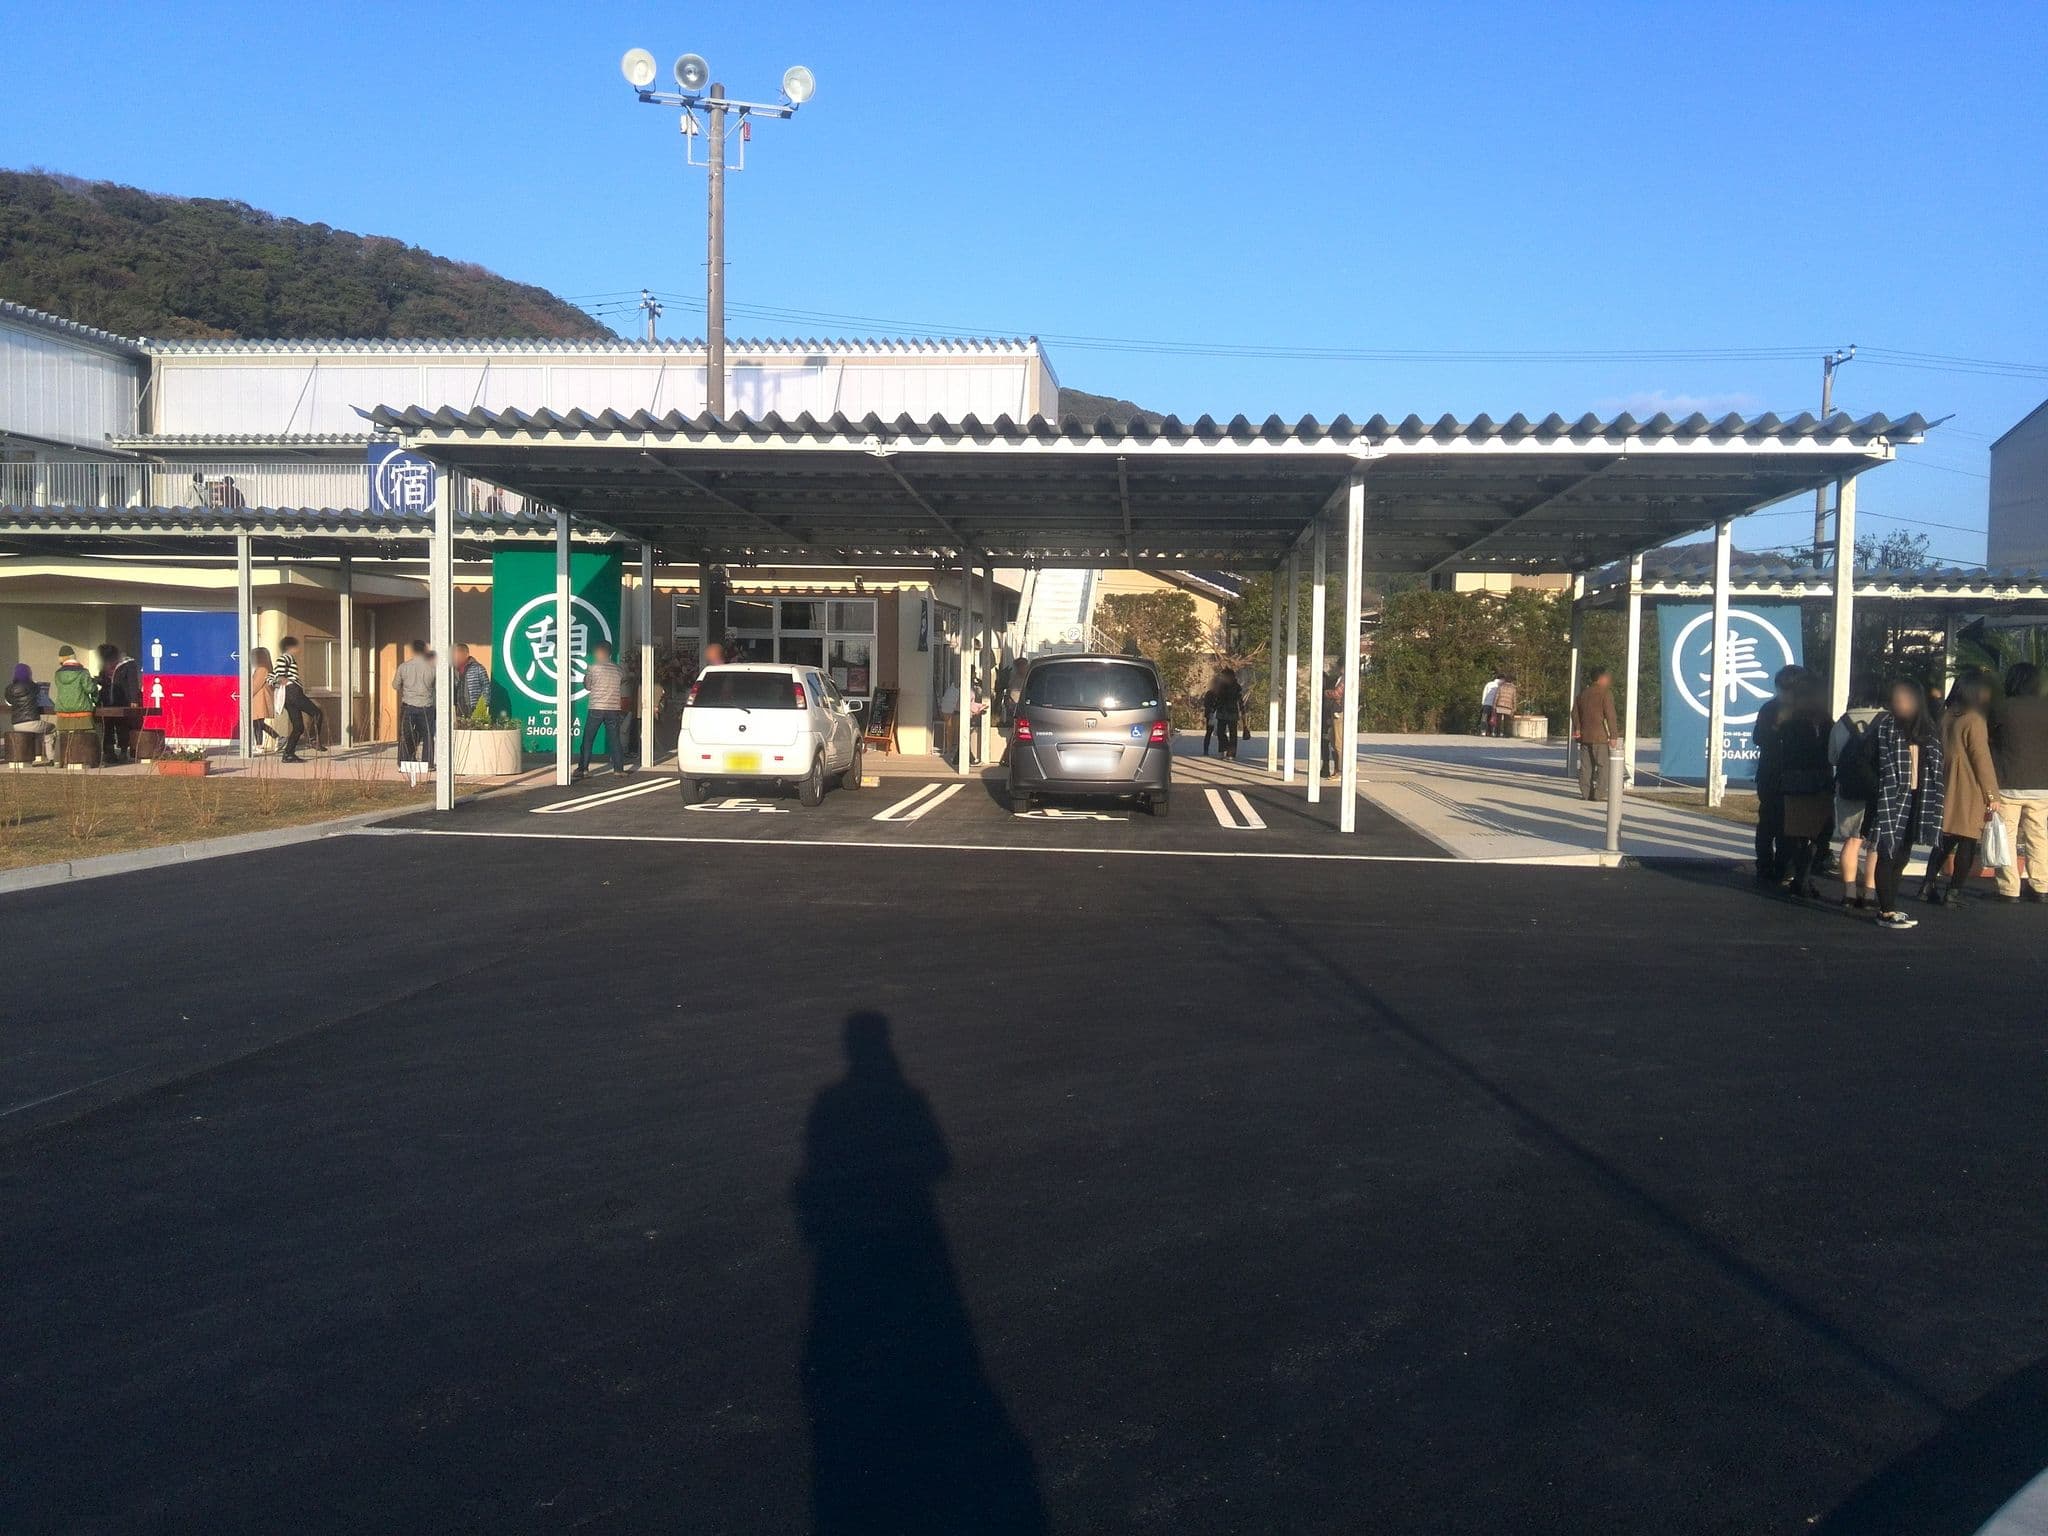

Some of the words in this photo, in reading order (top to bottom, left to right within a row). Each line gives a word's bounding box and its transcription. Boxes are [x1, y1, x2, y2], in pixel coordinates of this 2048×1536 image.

[391, 460, 429, 506] 宿
[1698, 629, 1774, 703] 集
[527, 716, 581, 726] HOA
